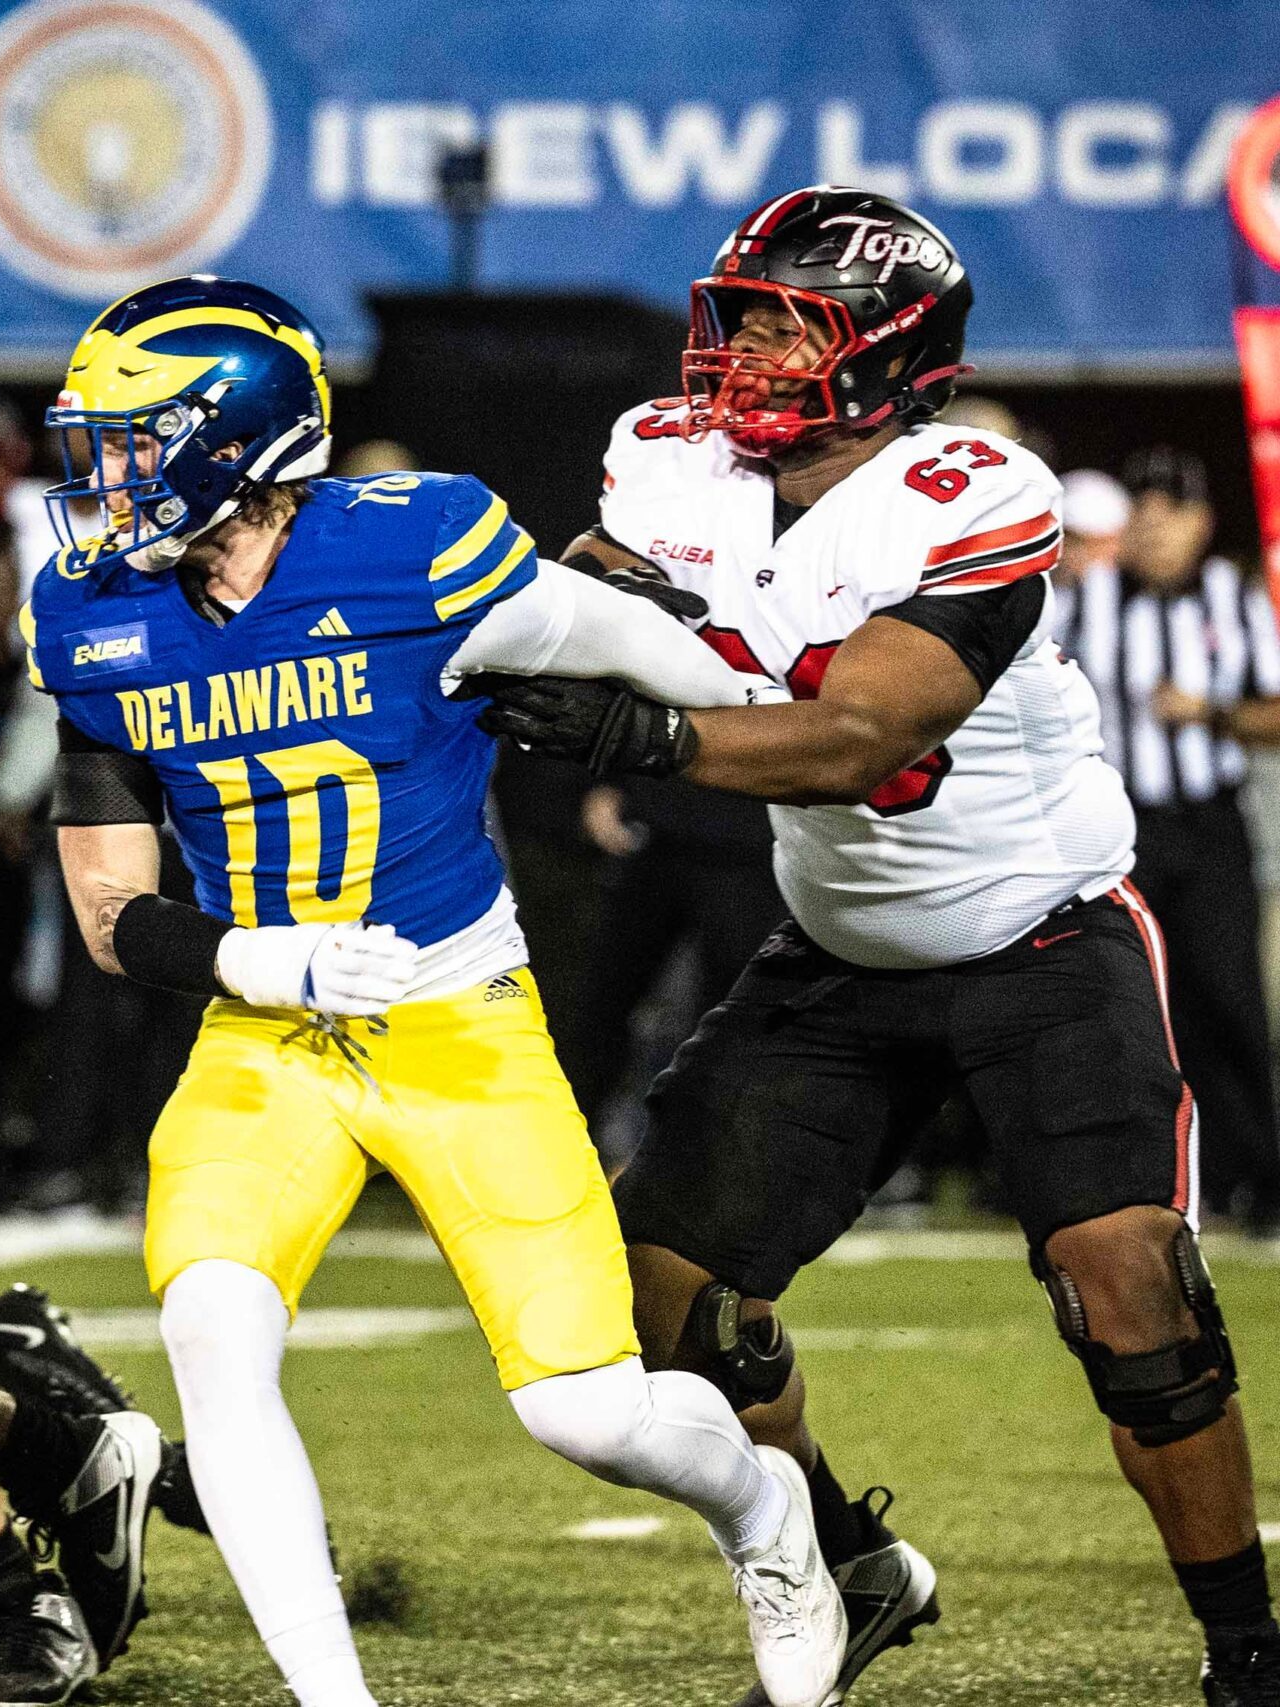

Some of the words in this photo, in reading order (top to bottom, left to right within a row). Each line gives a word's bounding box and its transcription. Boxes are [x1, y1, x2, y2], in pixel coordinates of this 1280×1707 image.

[818, 214, 946, 284] Tops
[904, 440, 1009, 504] 63
[648, 539, 715, 567] C-USA
[73, 635, 144, 666] C-USA
[115, 651, 373, 751] DELAWARE
[196, 738, 381, 929] 10
[483, 988, 529, 1002] adidas
